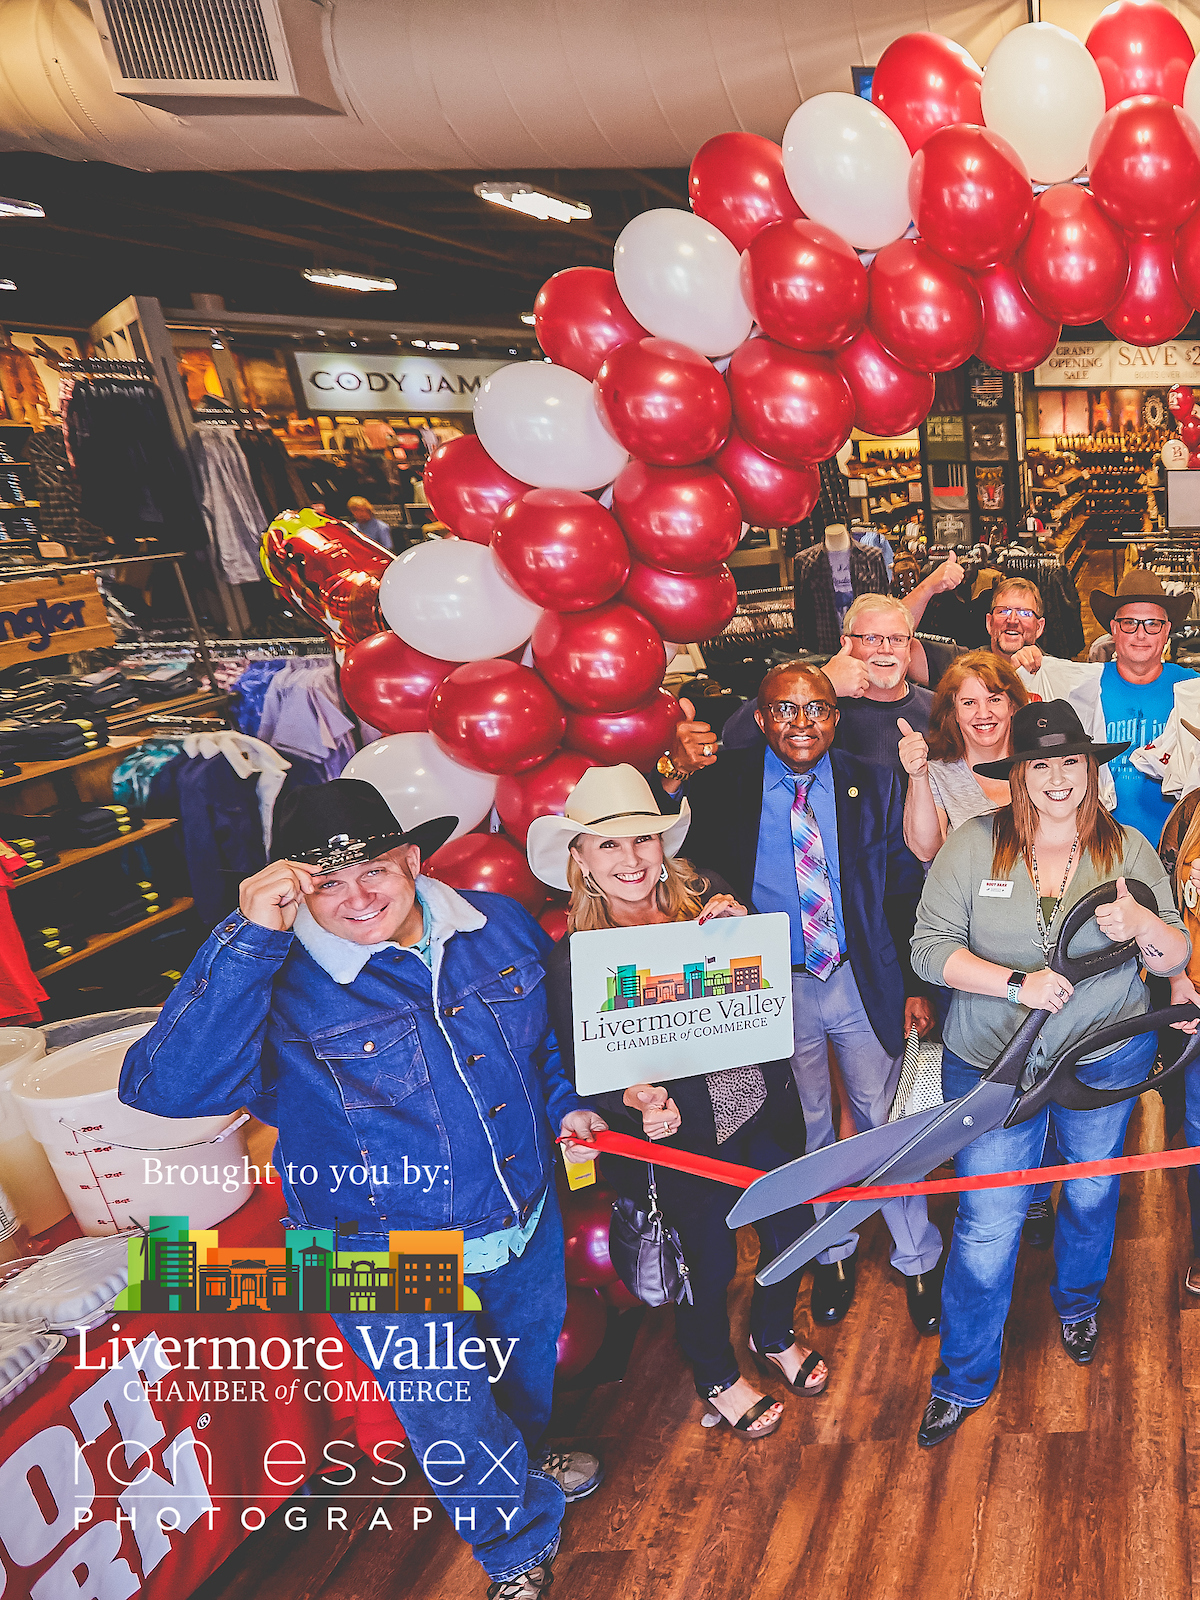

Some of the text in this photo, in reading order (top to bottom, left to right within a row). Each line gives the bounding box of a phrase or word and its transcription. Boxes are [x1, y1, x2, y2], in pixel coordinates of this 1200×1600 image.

[1056, 346, 1094, 355] GRAND
[1118, 345, 1177, 366] SAVE
[1049, 357, 1103, 368] OPENING
[309, 371, 406, 392] CODY
[1064, 370, 1089, 380] SALE
[581, 993, 787, 1042] Livermore Valley
[606, 1016, 769, 1052] CHAMBER of COMMERCE
[81, 1124, 104, 1133] 20qt
